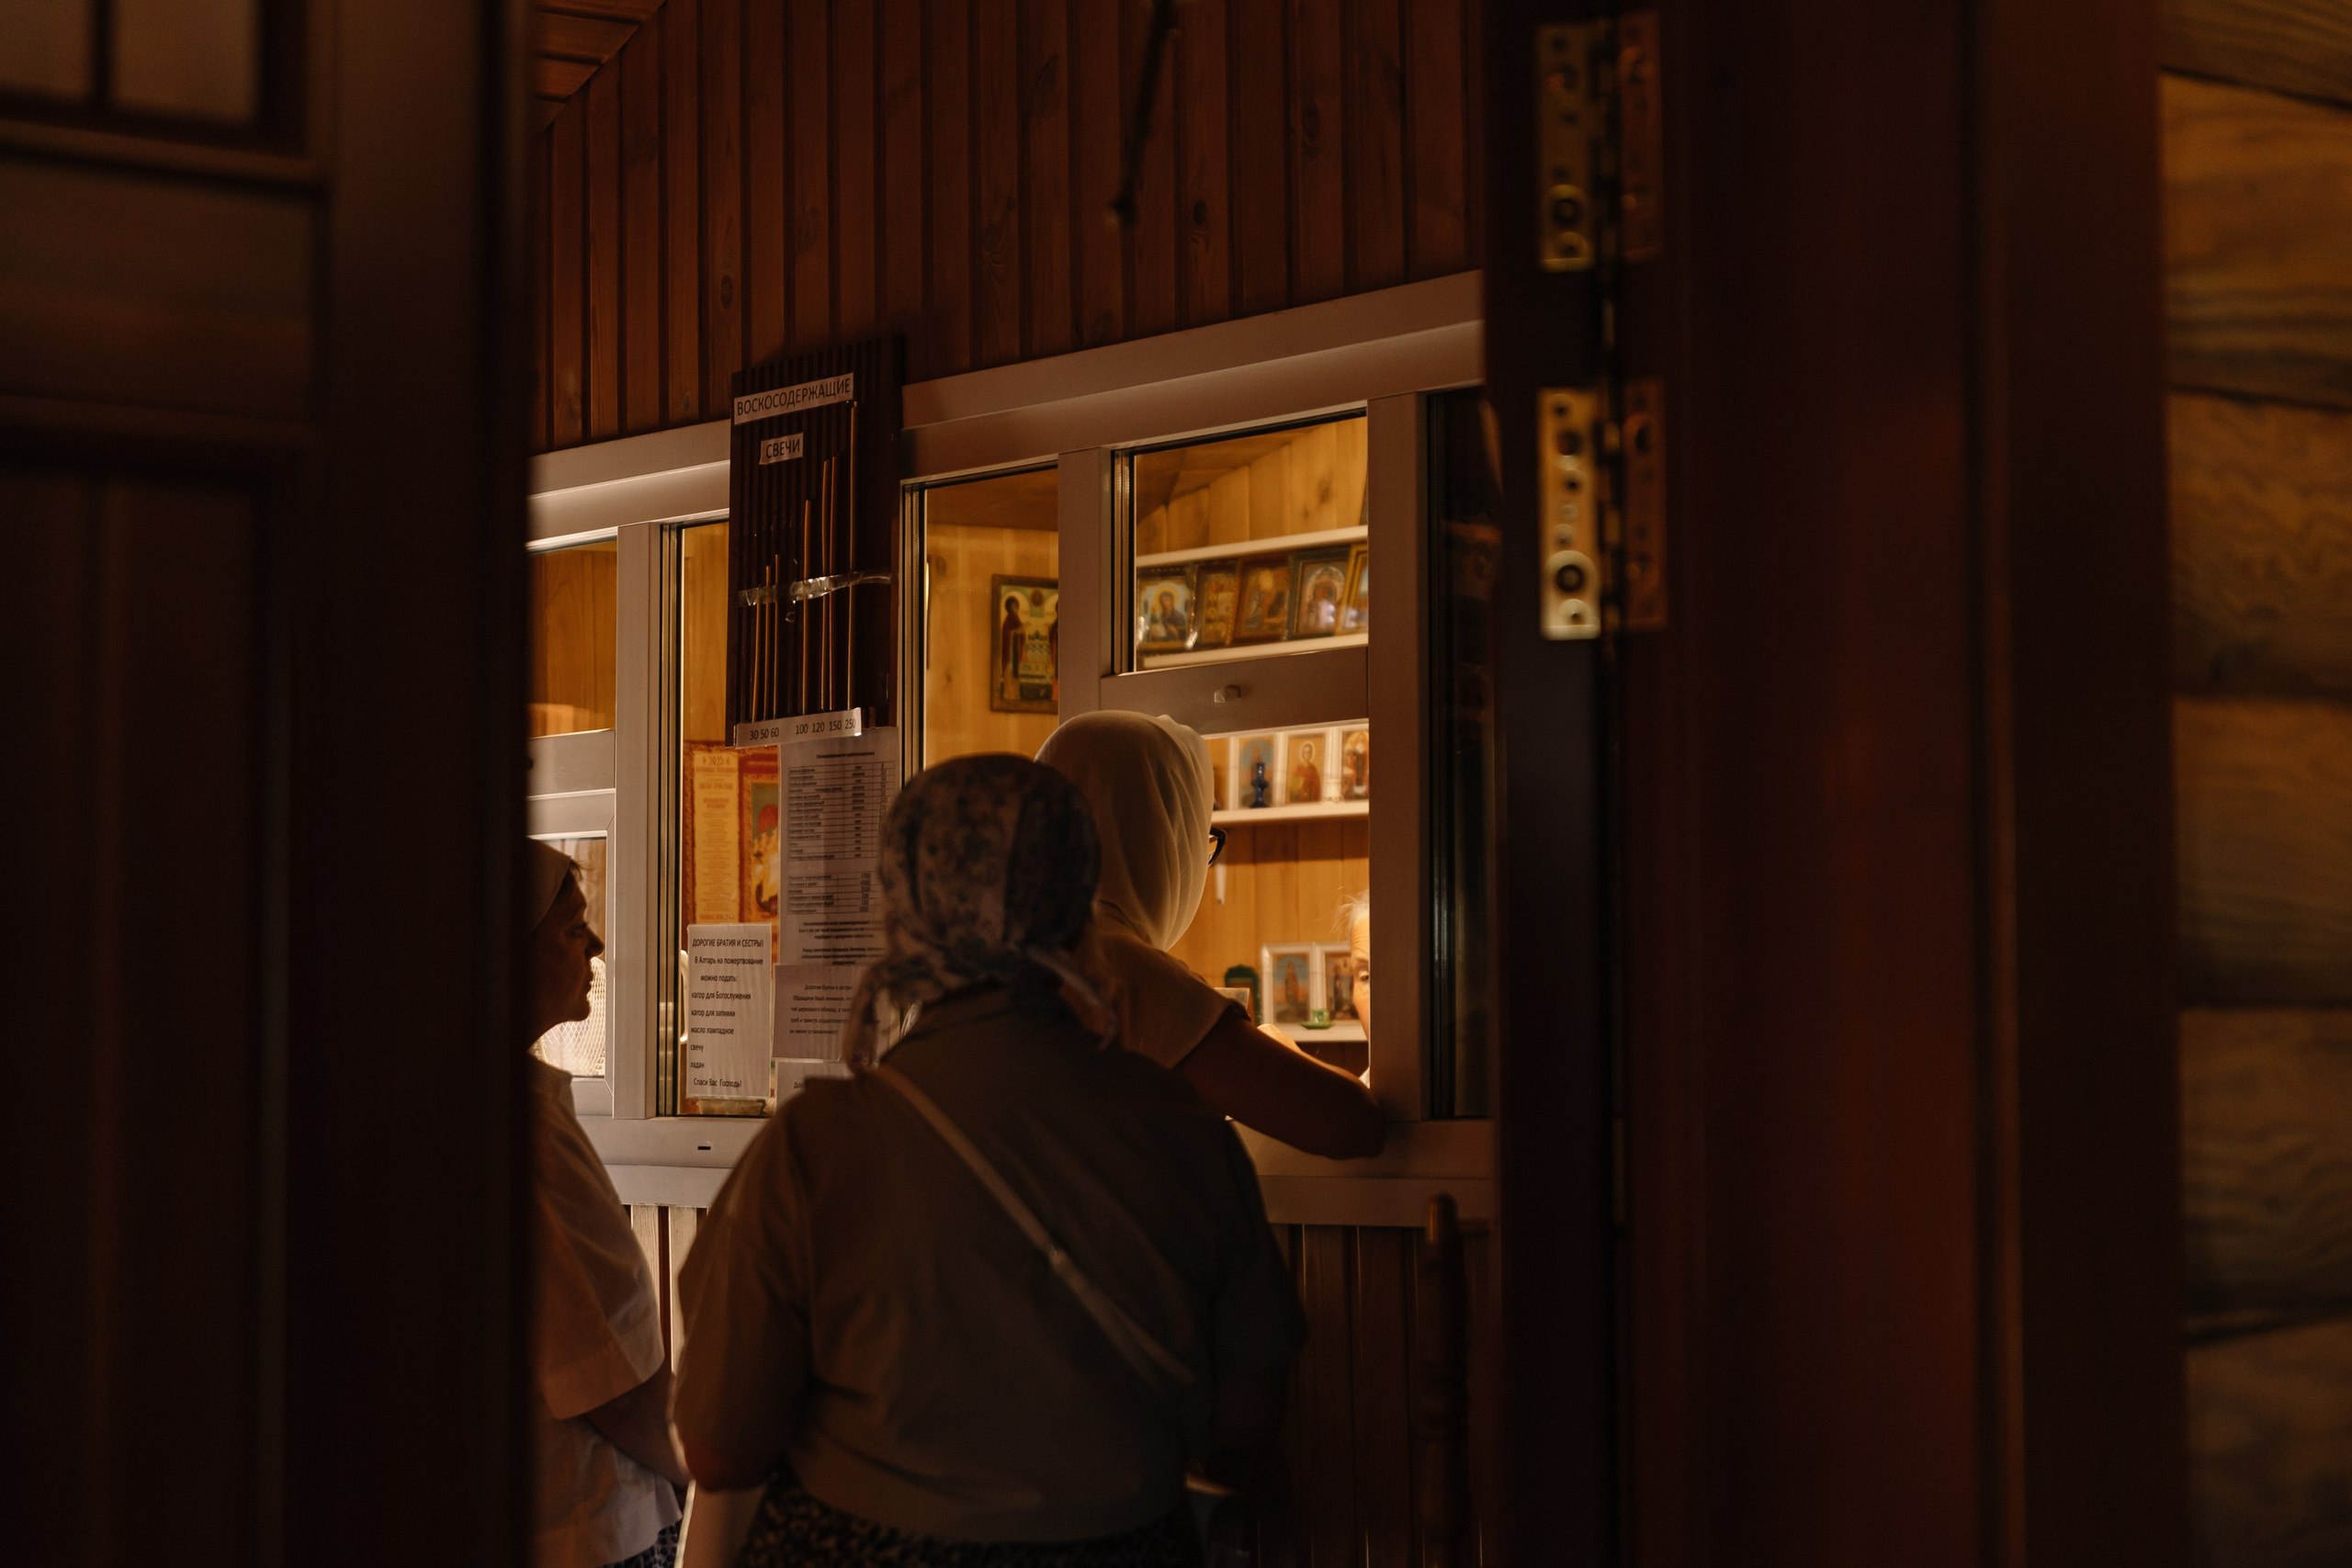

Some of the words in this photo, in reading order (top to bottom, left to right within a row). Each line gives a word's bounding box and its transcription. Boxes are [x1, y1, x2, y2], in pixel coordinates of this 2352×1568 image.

[737, 378, 851, 416] ВОСКОСОДЕРЖАЩИЕ
[765, 438, 800, 458] СВЕЧИ
[749, 730, 758, 740] 30
[760, 728, 769, 739] 50
[770, 727, 780, 737] 60
[795, 723, 808, 734] 100
[812, 722, 825, 733] 120
[828, 720, 842, 731] 150
[692, 939, 715, 947] ДОРОГИЕ
[717, 939, 736, 947] БРАТИЯ
[699, 956, 716, 965] Алтарь
[716, 991, 751, 1001] Богослужения
[720, 1079, 742, 1088] Господь!
